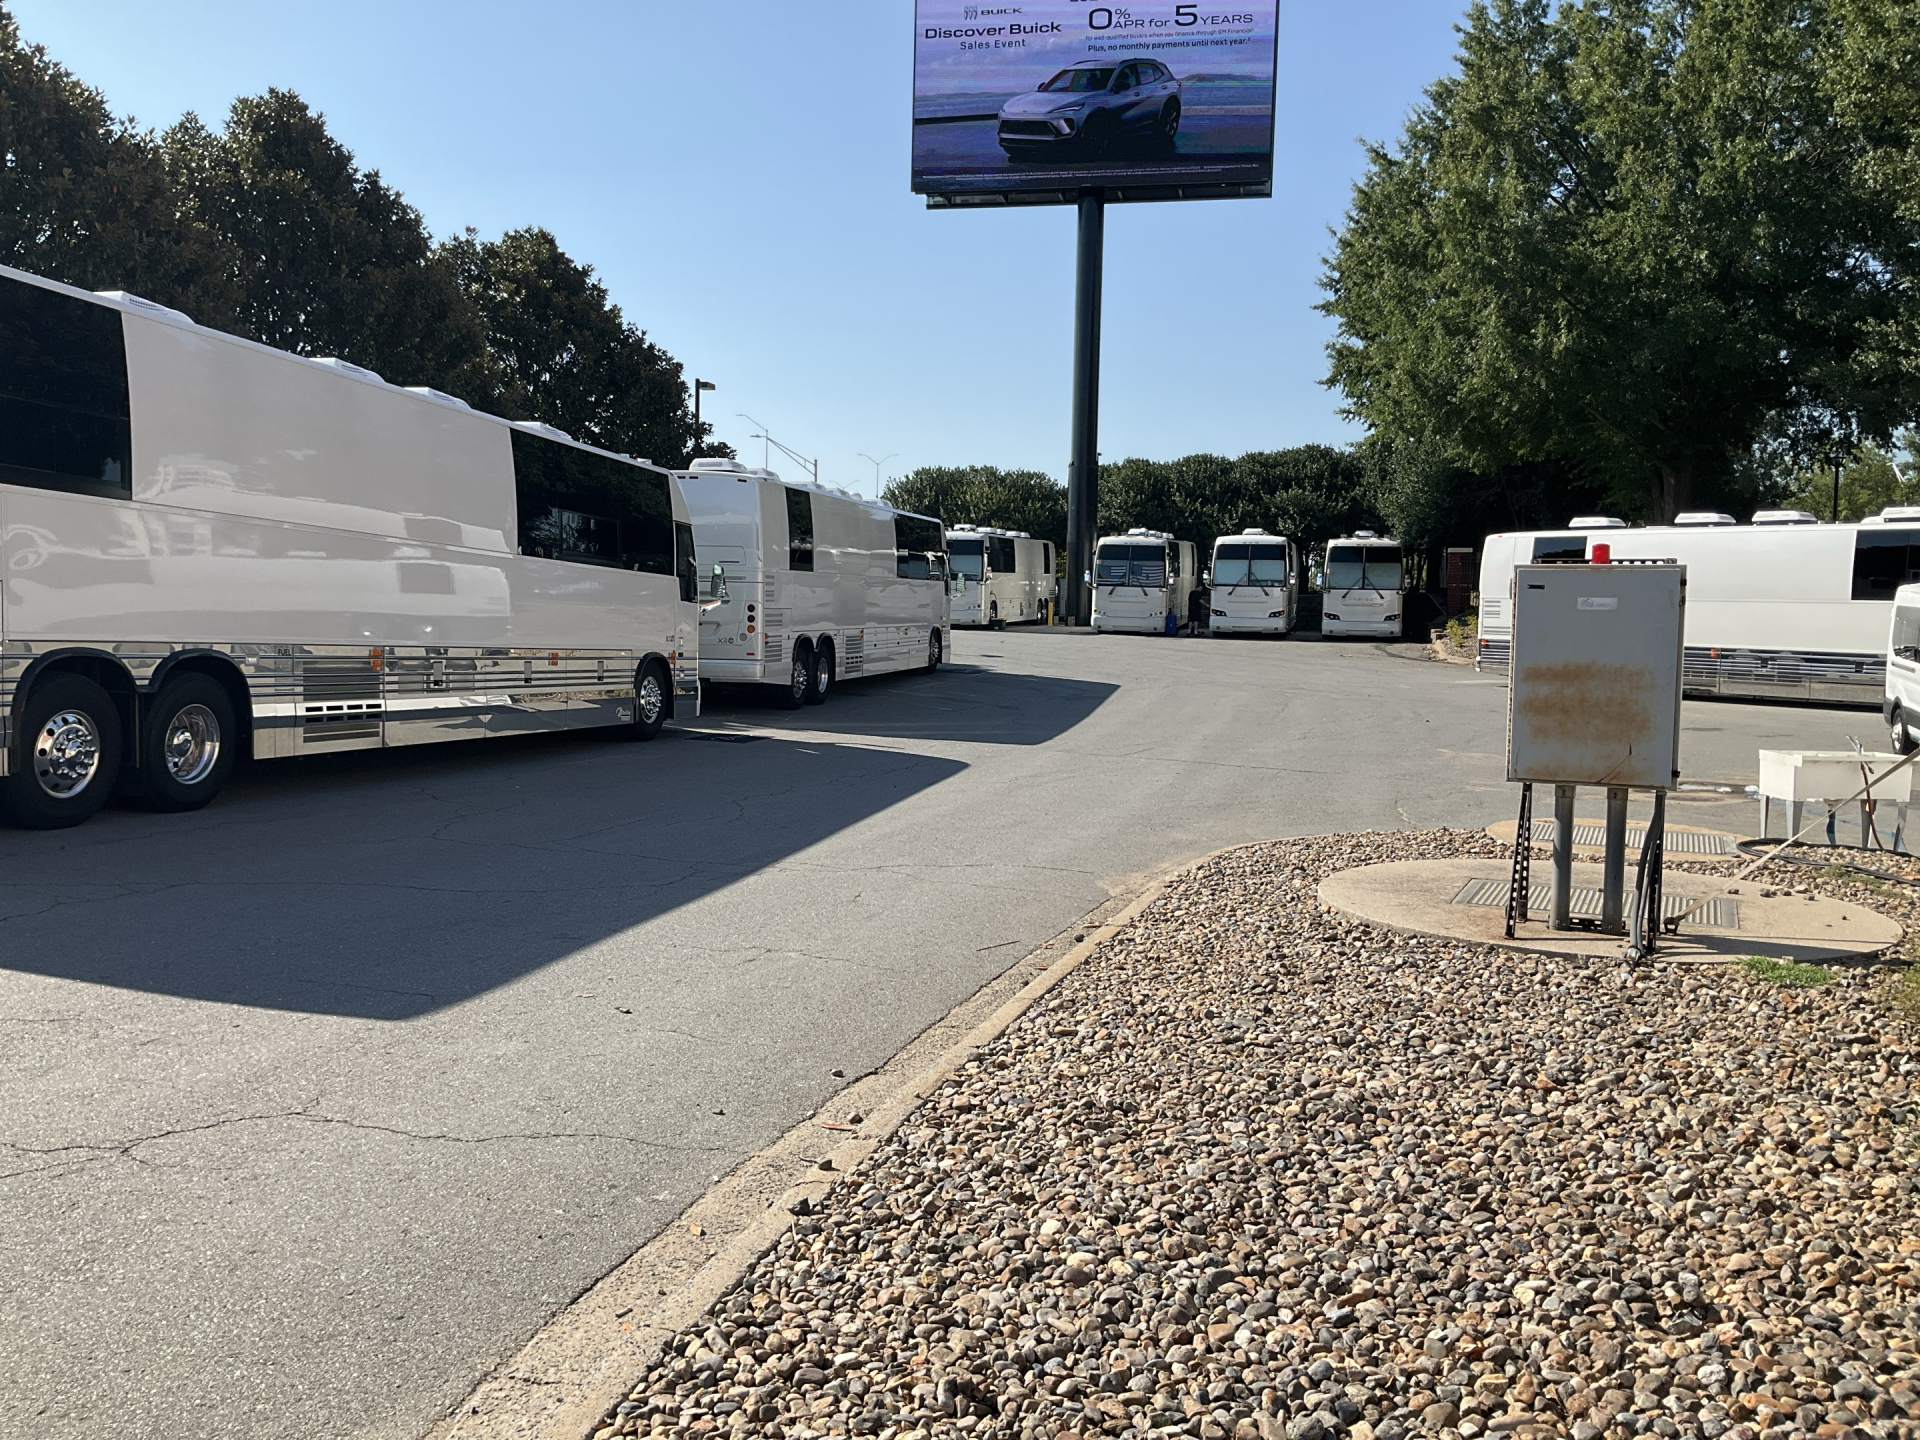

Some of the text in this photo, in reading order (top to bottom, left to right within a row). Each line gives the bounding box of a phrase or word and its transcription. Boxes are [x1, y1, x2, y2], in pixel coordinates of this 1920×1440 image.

[981, 8, 1023, 16] BUICK
[1113, 19, 1145, 29] APR
[1149, 18, 1170, 28] for
[1175, 4, 1198, 27] 5
[1200, 14, 1253, 25] YEARS
[925, 22, 1062, 39] Discover Buick
[960, 38, 1026, 50] Sales Event
[1119, 42, 1150, 51] monthly
[1151, 41, 1190, 50] payments
[1191, 39, 1208, 47] until
[1210, 38, 1228, 46] next
